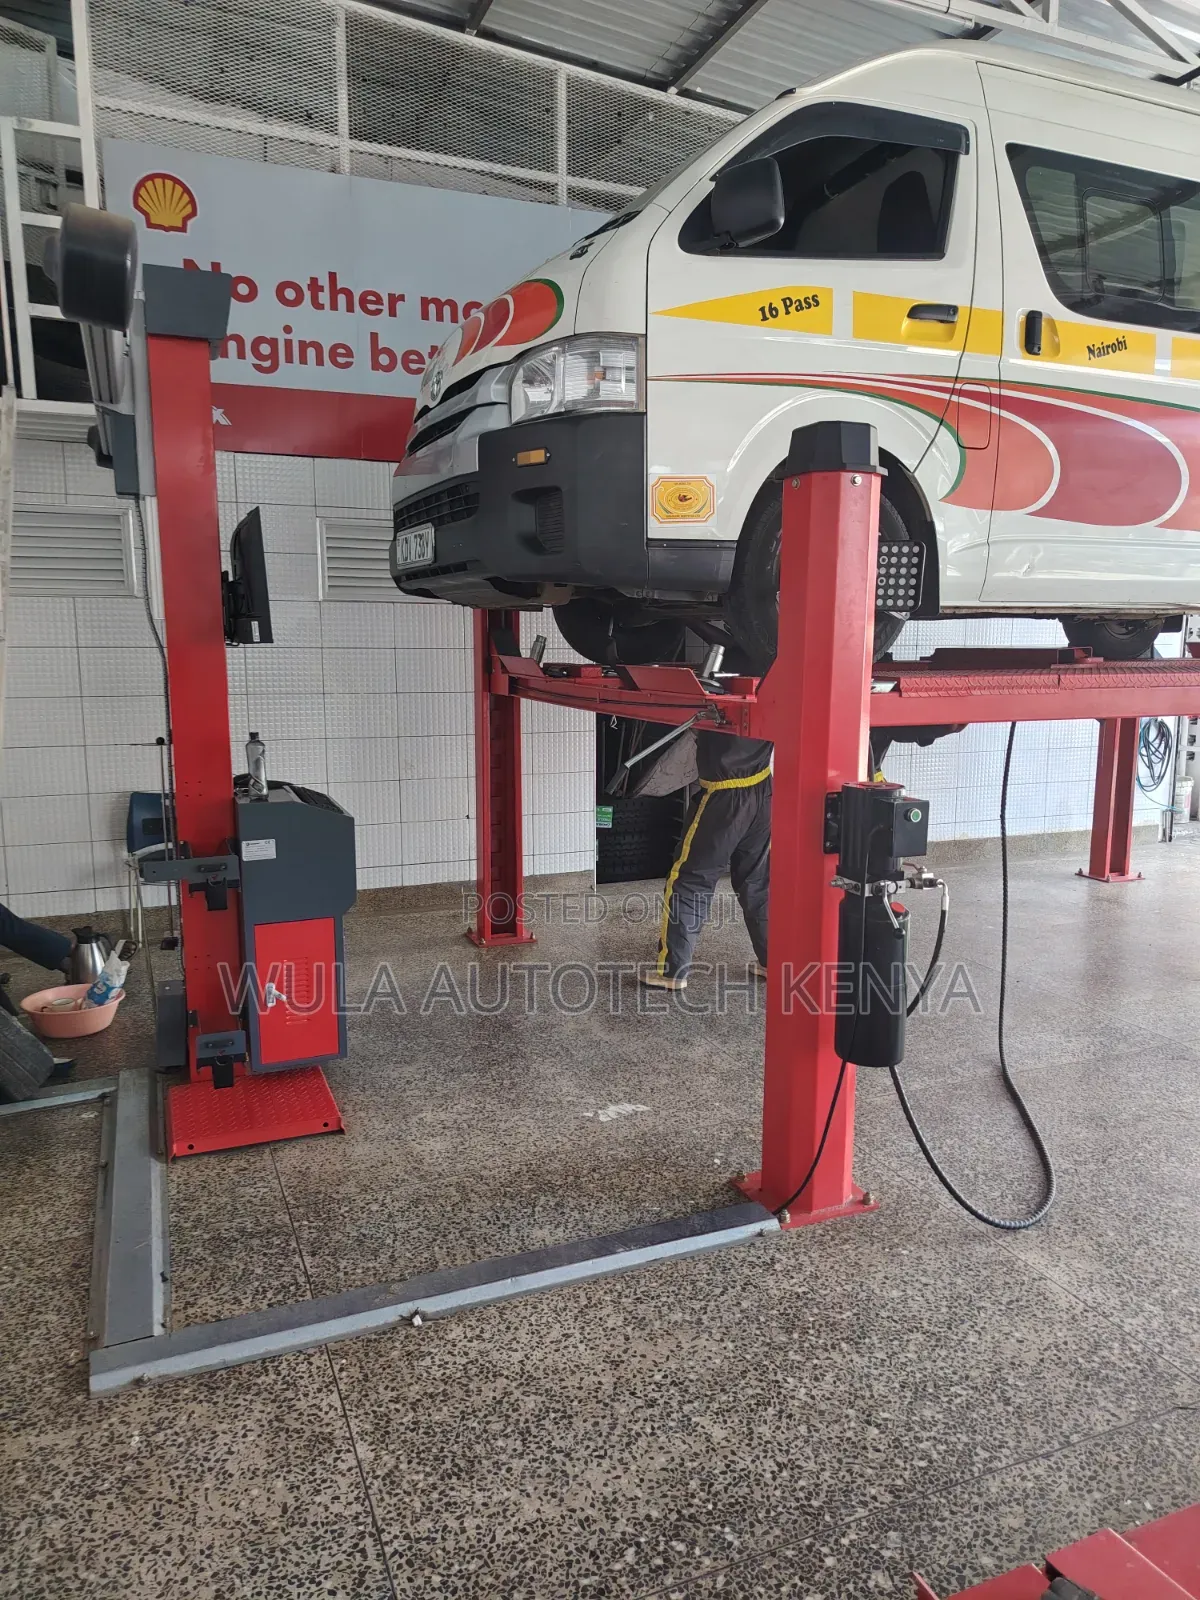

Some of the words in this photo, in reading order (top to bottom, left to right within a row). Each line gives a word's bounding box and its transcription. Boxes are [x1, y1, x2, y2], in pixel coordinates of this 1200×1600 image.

[182, 258, 258, 303] o
[275, 271, 406, 316] other
[758, 302, 779, 322] 16
[781, 294, 820, 316] Pass
[219, 324, 354, 374] ngine
[1086, 335, 1128, 361] Nairobi
